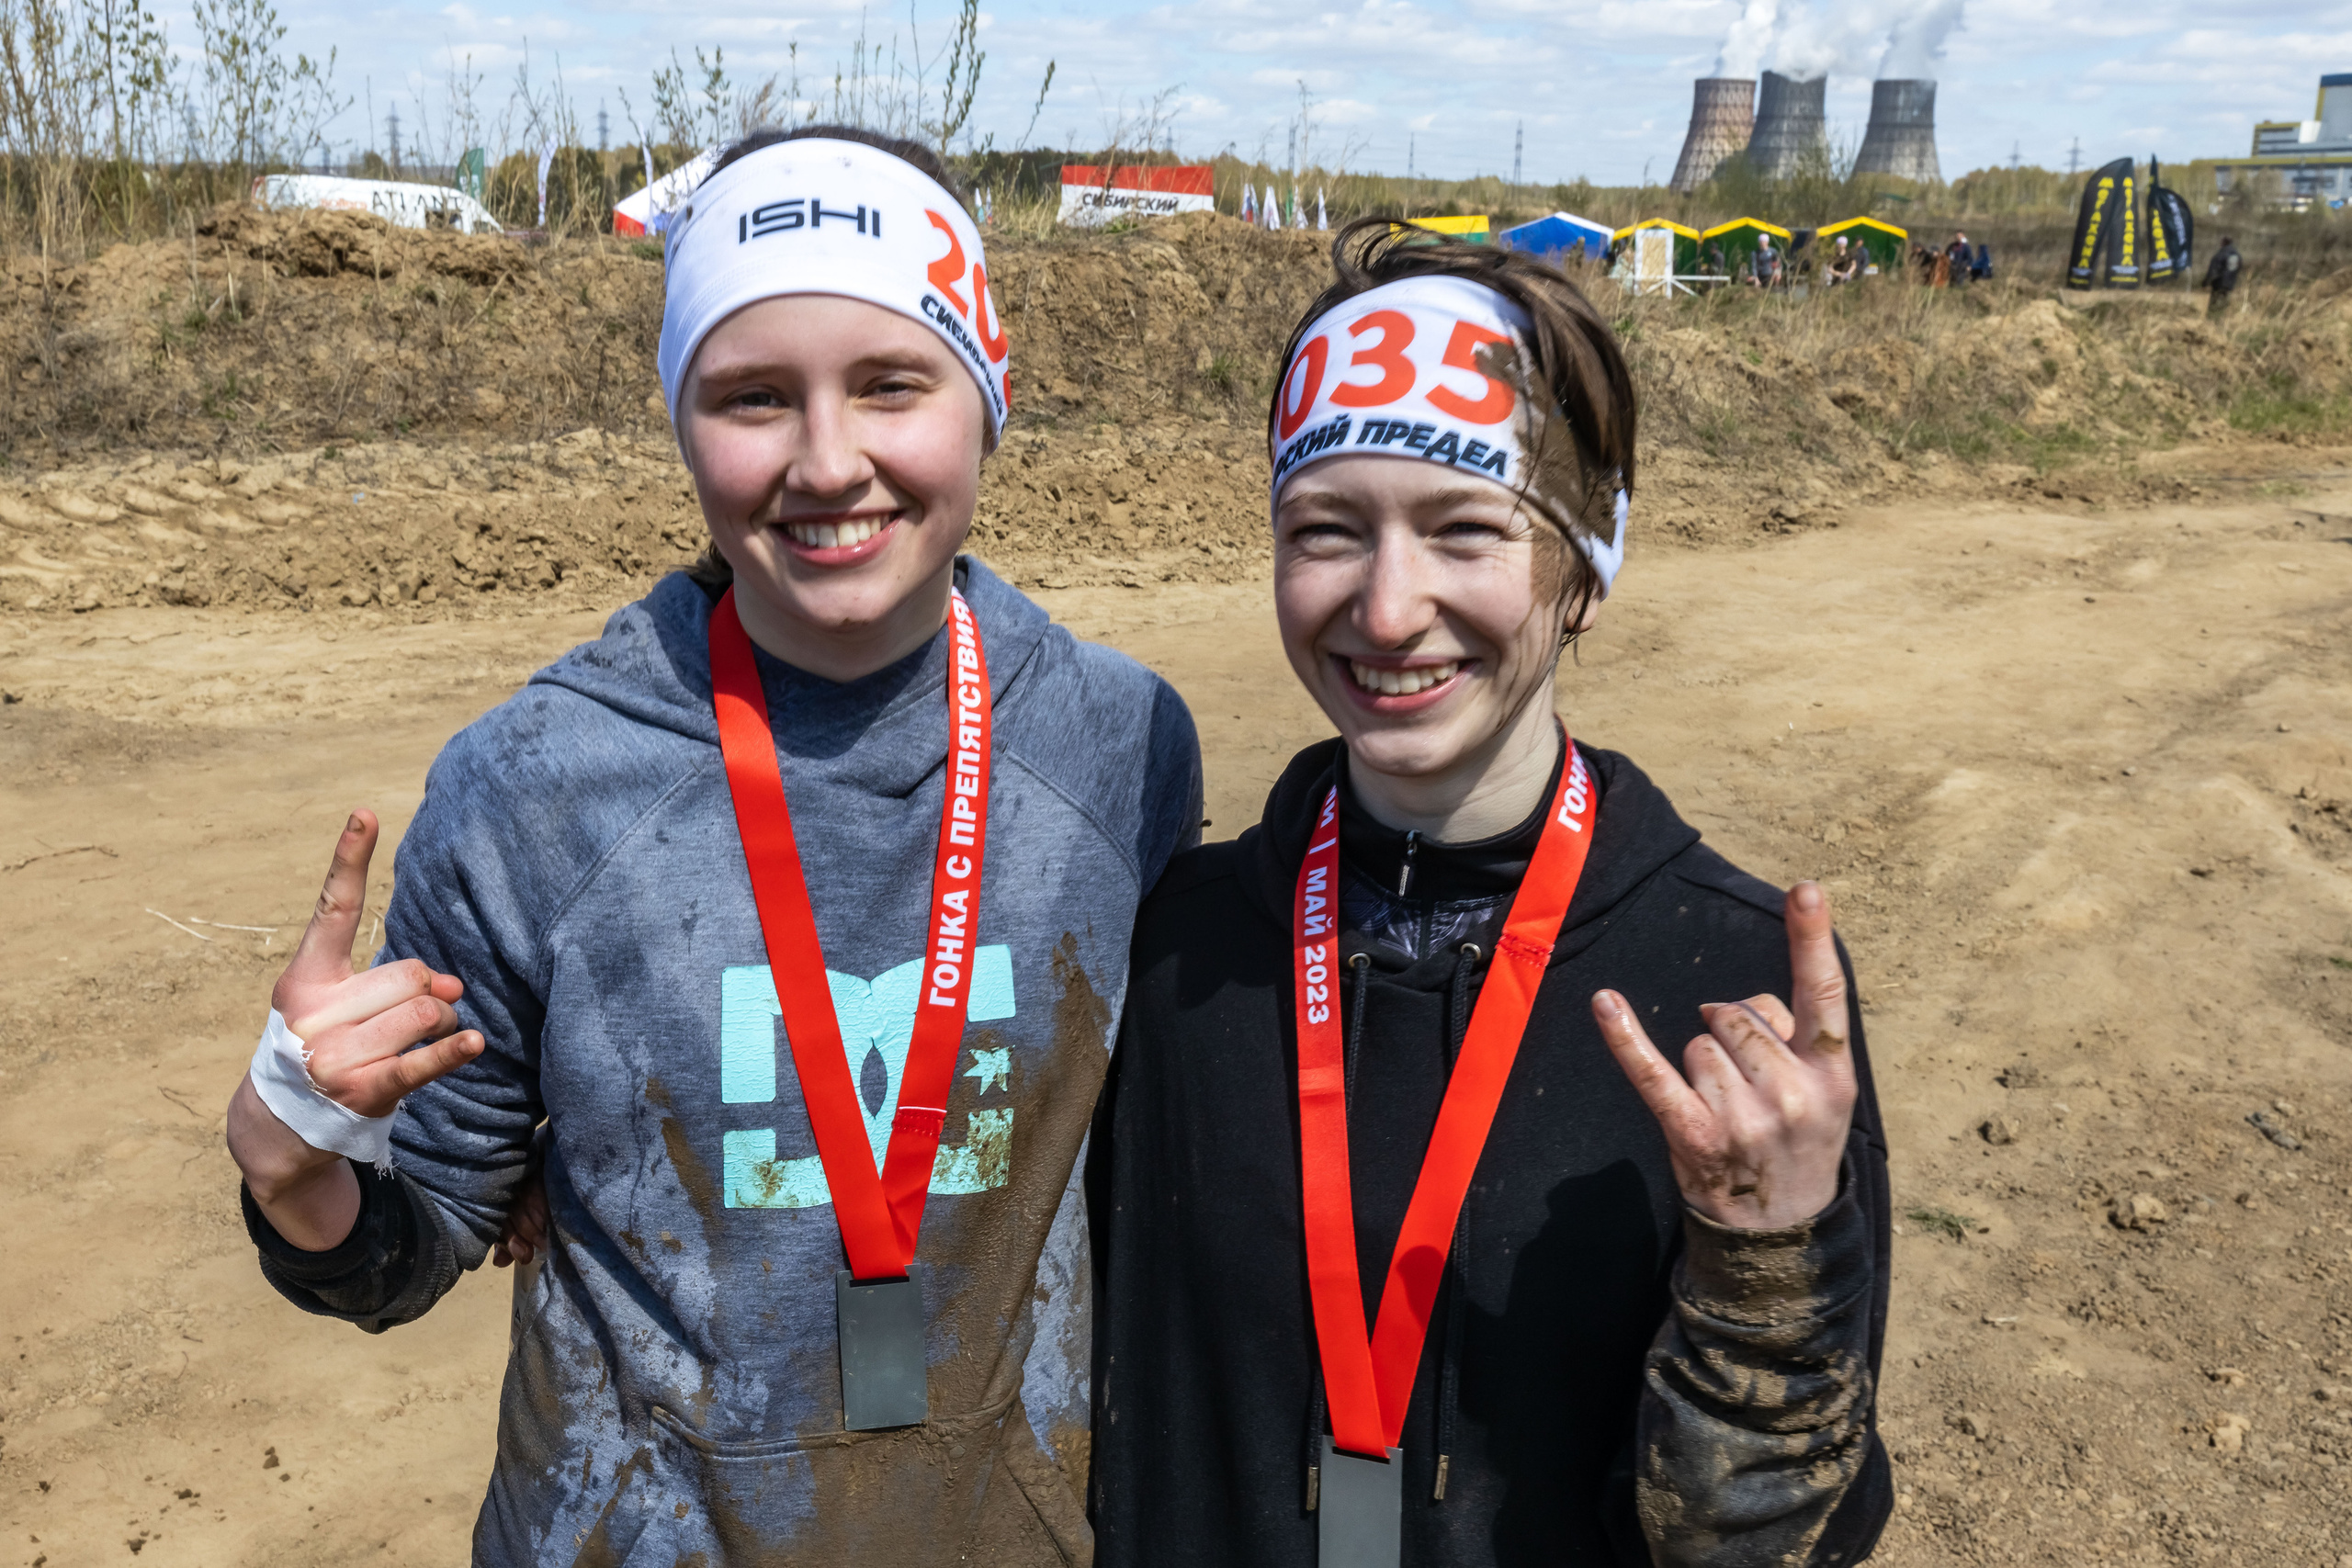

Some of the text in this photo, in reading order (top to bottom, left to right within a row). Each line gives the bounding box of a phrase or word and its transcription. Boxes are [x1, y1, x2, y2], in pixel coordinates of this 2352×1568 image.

[740, 197, 880, 245] ISHI
[1082, 192, 1180, 212] СИБИРСКИЙ
[1355, 418, 1510, 479] ПРЕДЕЛ
[1305, 866, 1333, 937] МАЙ
[929, 889, 969, 1007] ГОНКА
[1305, 946, 1329, 1024] 2023
